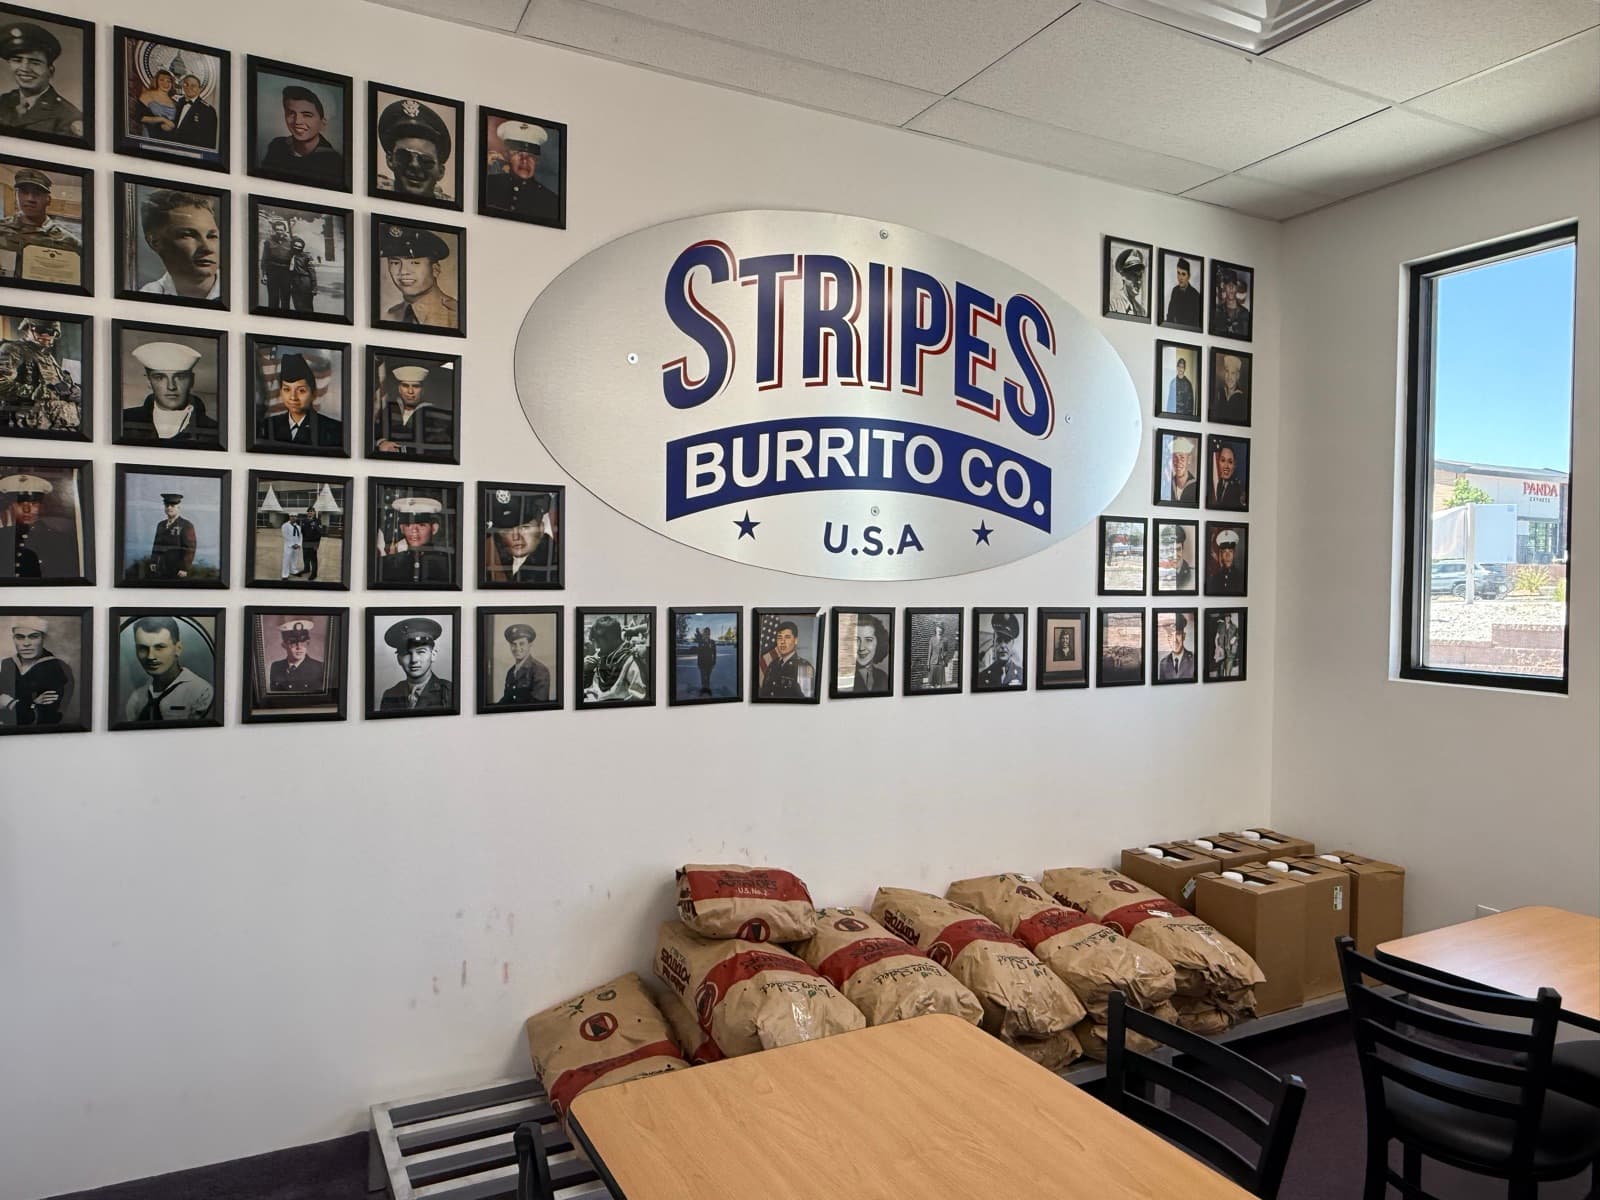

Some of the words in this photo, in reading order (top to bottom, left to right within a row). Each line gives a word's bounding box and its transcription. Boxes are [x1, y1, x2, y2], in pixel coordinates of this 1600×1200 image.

[662, 239, 1056, 440] STRIPES
[685, 428, 944, 500] BURRITO
[960, 448, 1045, 516] CO.
[1523, 482, 1558, 496] PANDA
[823, 522, 924, 557] U.S.A
